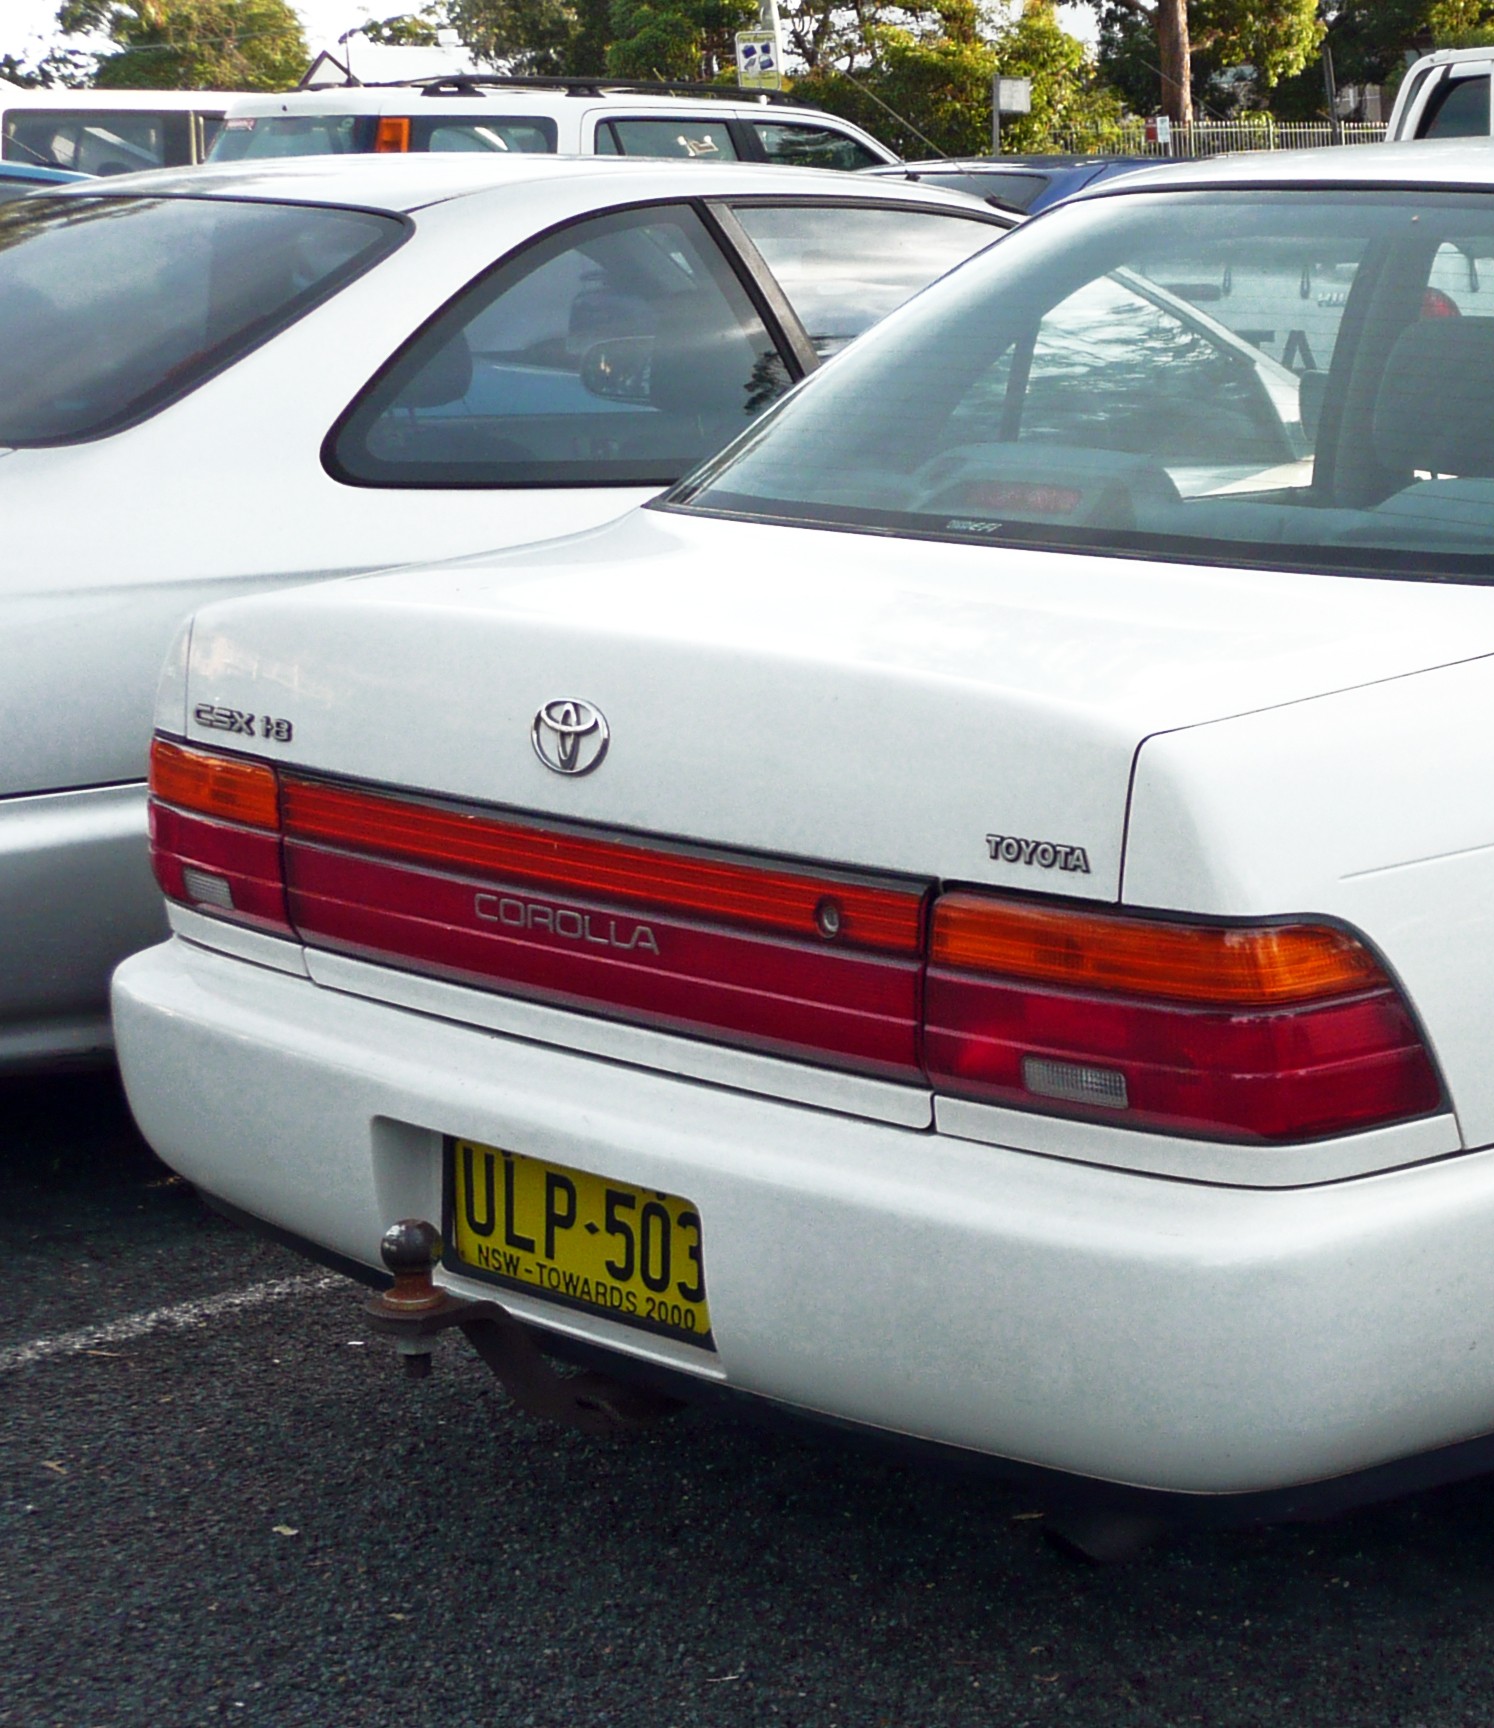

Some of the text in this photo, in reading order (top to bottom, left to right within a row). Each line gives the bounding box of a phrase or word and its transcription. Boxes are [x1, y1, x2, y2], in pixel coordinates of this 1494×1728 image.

[194, 703, 256, 737] CSX
[986, 834, 1091, 874] TOYOTA
[474, 892, 661, 956] COROLLA
[645, 1297, 696, 1331] 2000
